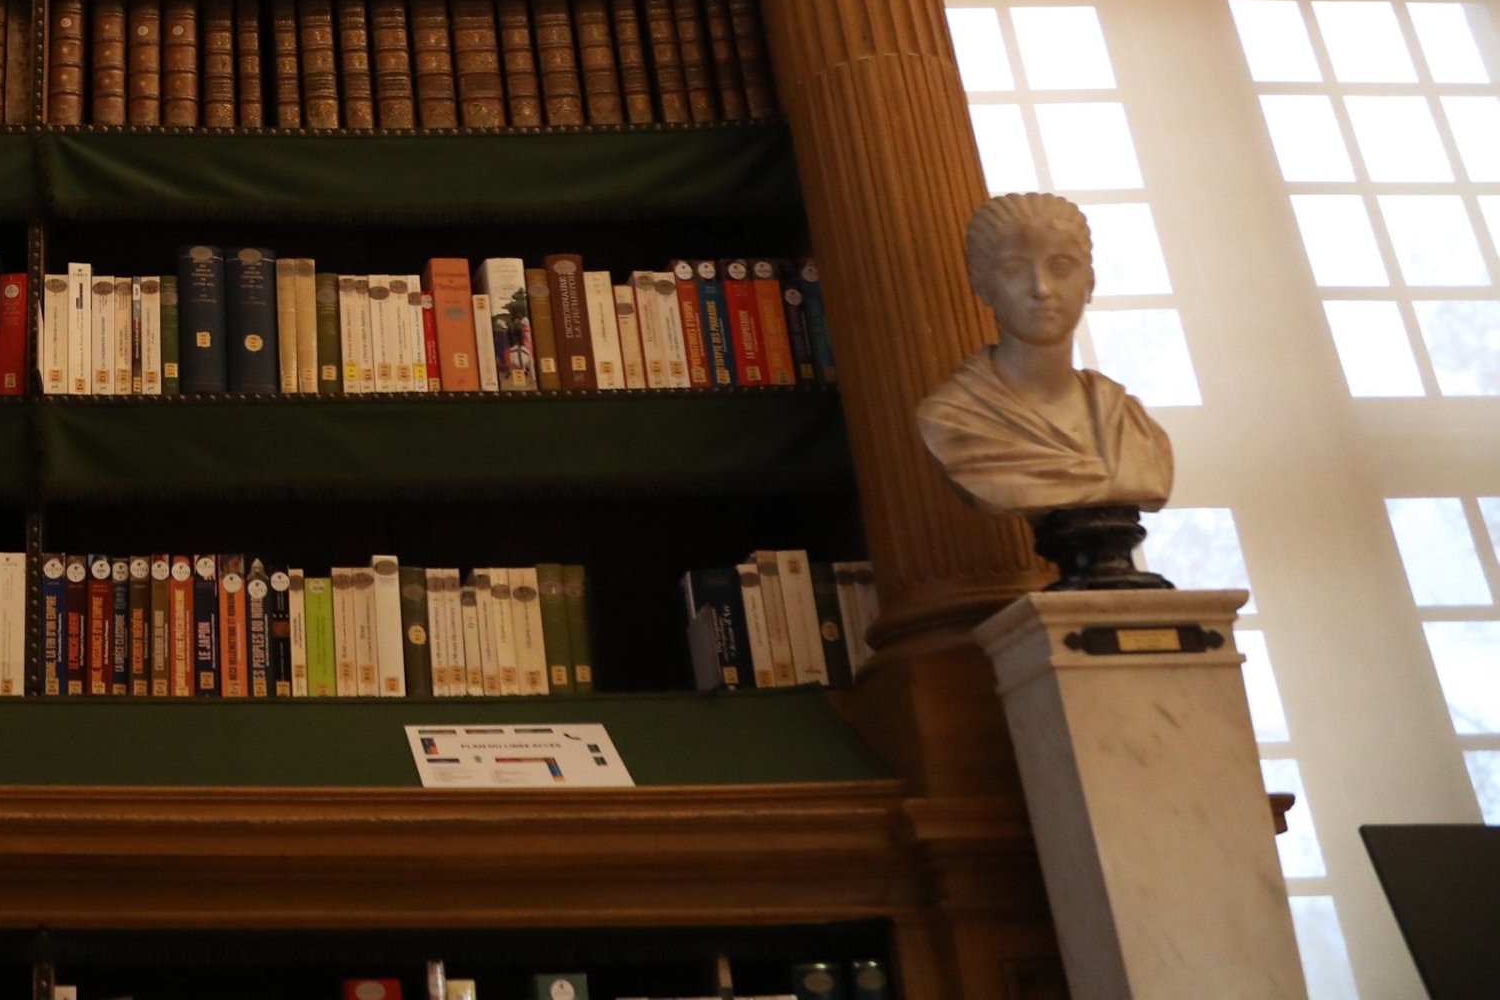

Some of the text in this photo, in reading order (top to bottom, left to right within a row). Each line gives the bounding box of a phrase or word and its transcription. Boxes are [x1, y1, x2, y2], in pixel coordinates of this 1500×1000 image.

[198, 622, 211, 660] LE JAPON
[253, 670, 266, 680] ES
